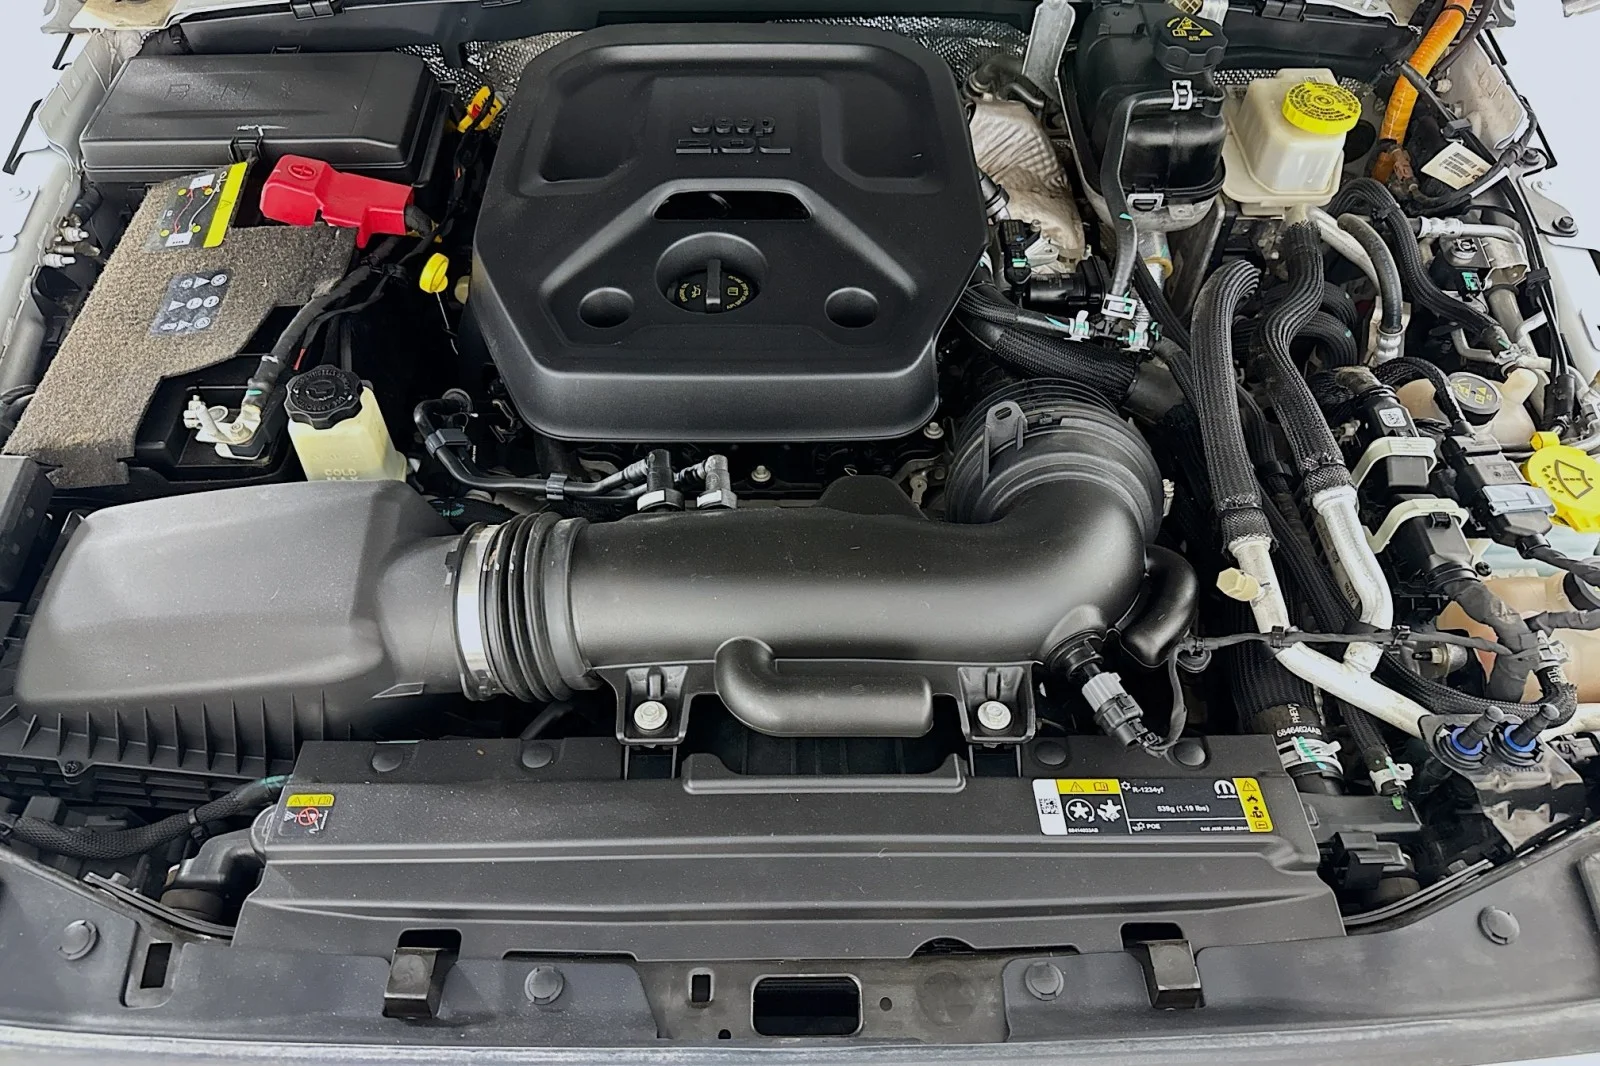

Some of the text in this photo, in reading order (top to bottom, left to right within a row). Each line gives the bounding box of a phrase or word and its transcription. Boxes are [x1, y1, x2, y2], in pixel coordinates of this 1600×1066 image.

[690, 115, 776, 136] Jeep
[675, 137, 792, 154] 2.0L
[324, 468, 357, 477] COLD
[1131, 786, 1164, 794] R-1234yf
